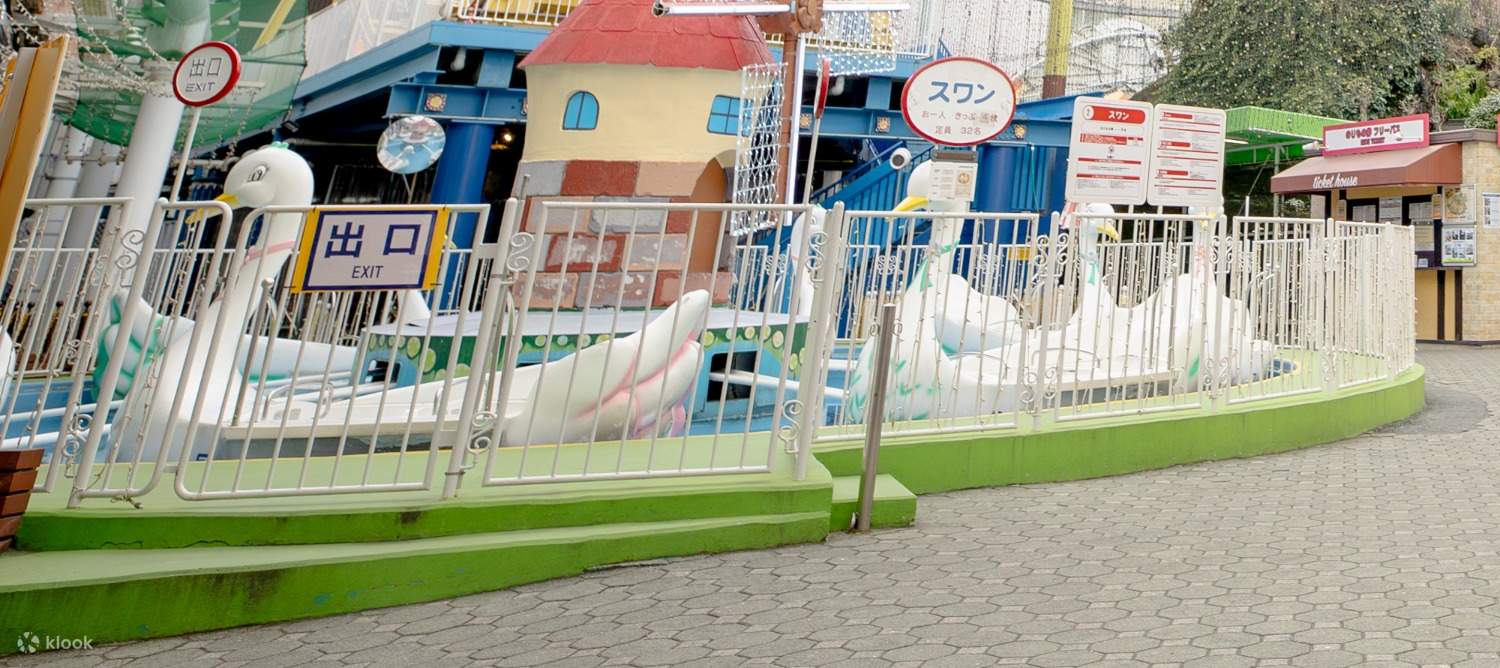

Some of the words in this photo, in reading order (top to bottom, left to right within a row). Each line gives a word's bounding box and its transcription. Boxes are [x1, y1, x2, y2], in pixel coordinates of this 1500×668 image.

[189, 57, 222, 78] 出口
[185, 81, 216, 92] EXIT
[928, 81, 996, 104] スワン
[1108, 110, 1130, 121] スワン
[1312, 173, 1334, 189] ticket
[1334, 172, 1359, 187] house
[324, 222, 422, 258] 出口
[352, 265, 384, 279] EXIT
